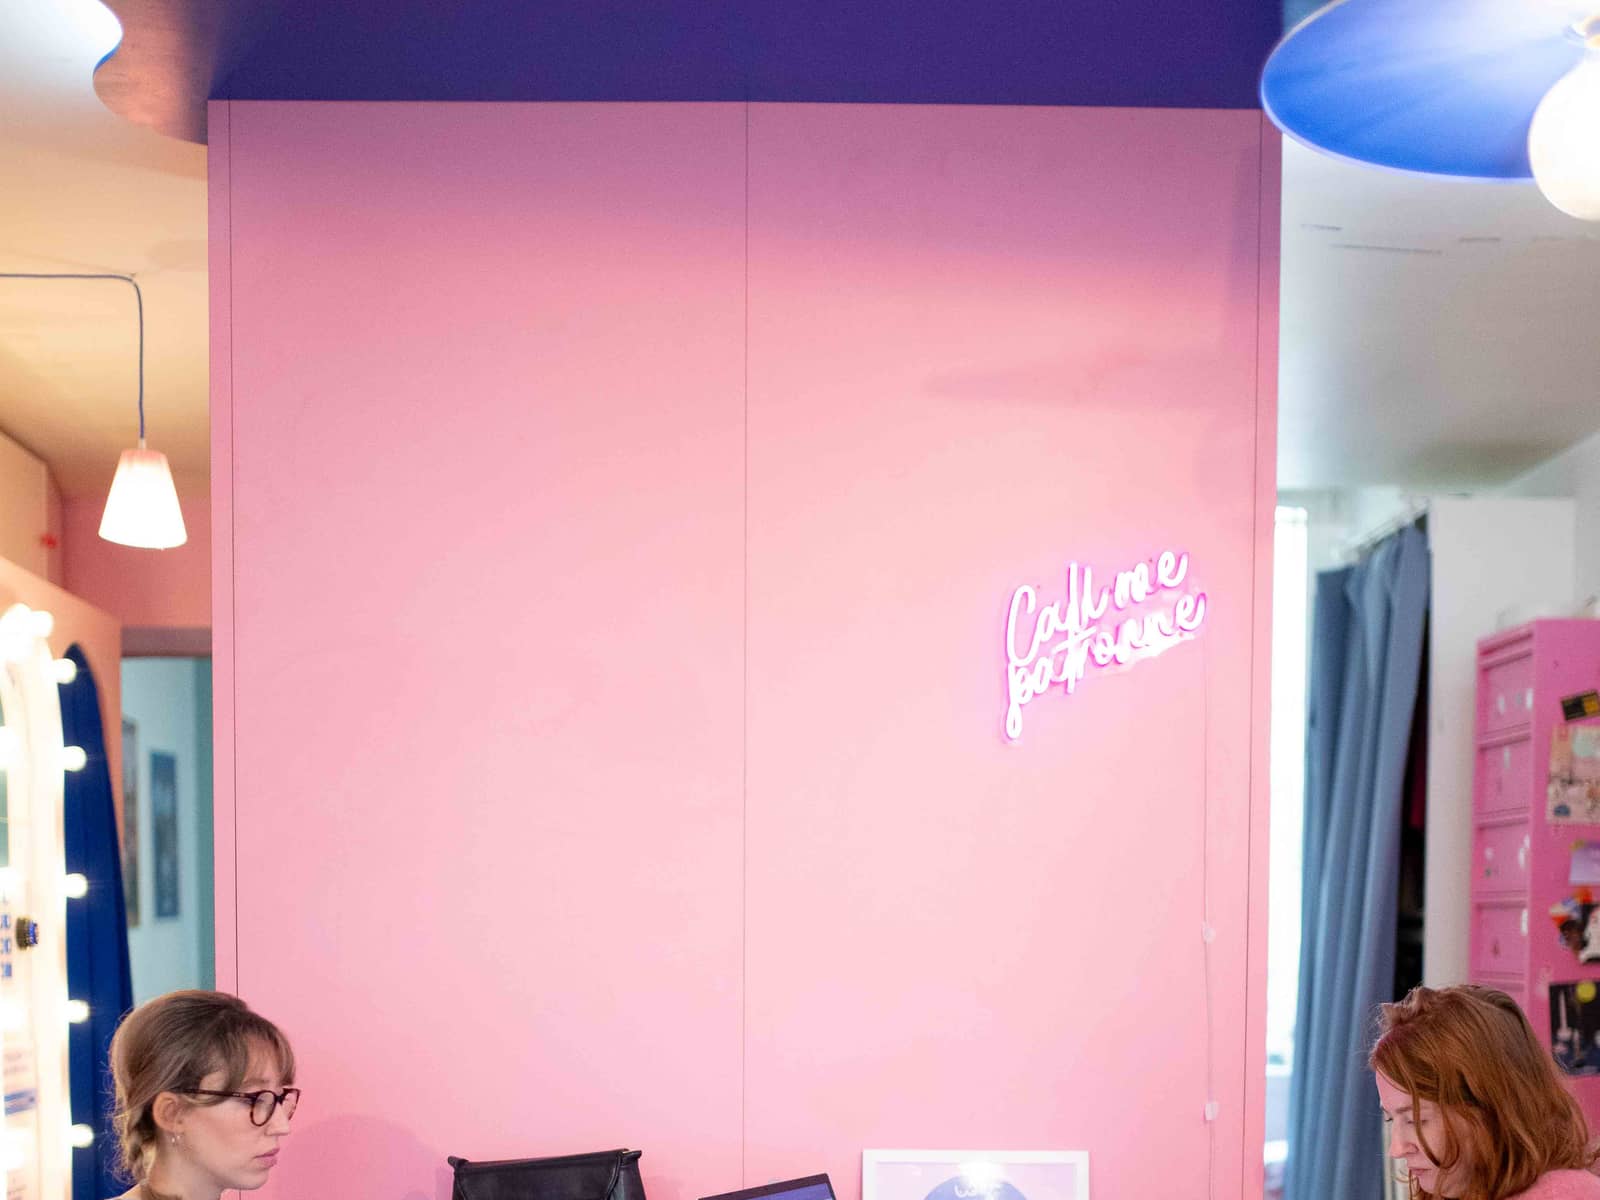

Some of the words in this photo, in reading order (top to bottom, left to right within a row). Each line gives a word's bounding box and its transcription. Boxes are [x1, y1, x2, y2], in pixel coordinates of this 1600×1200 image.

[1005, 592, 1206, 740] patronne
[1006, 561, 1110, 667] Call
[1111, 550, 1188, 610] me
